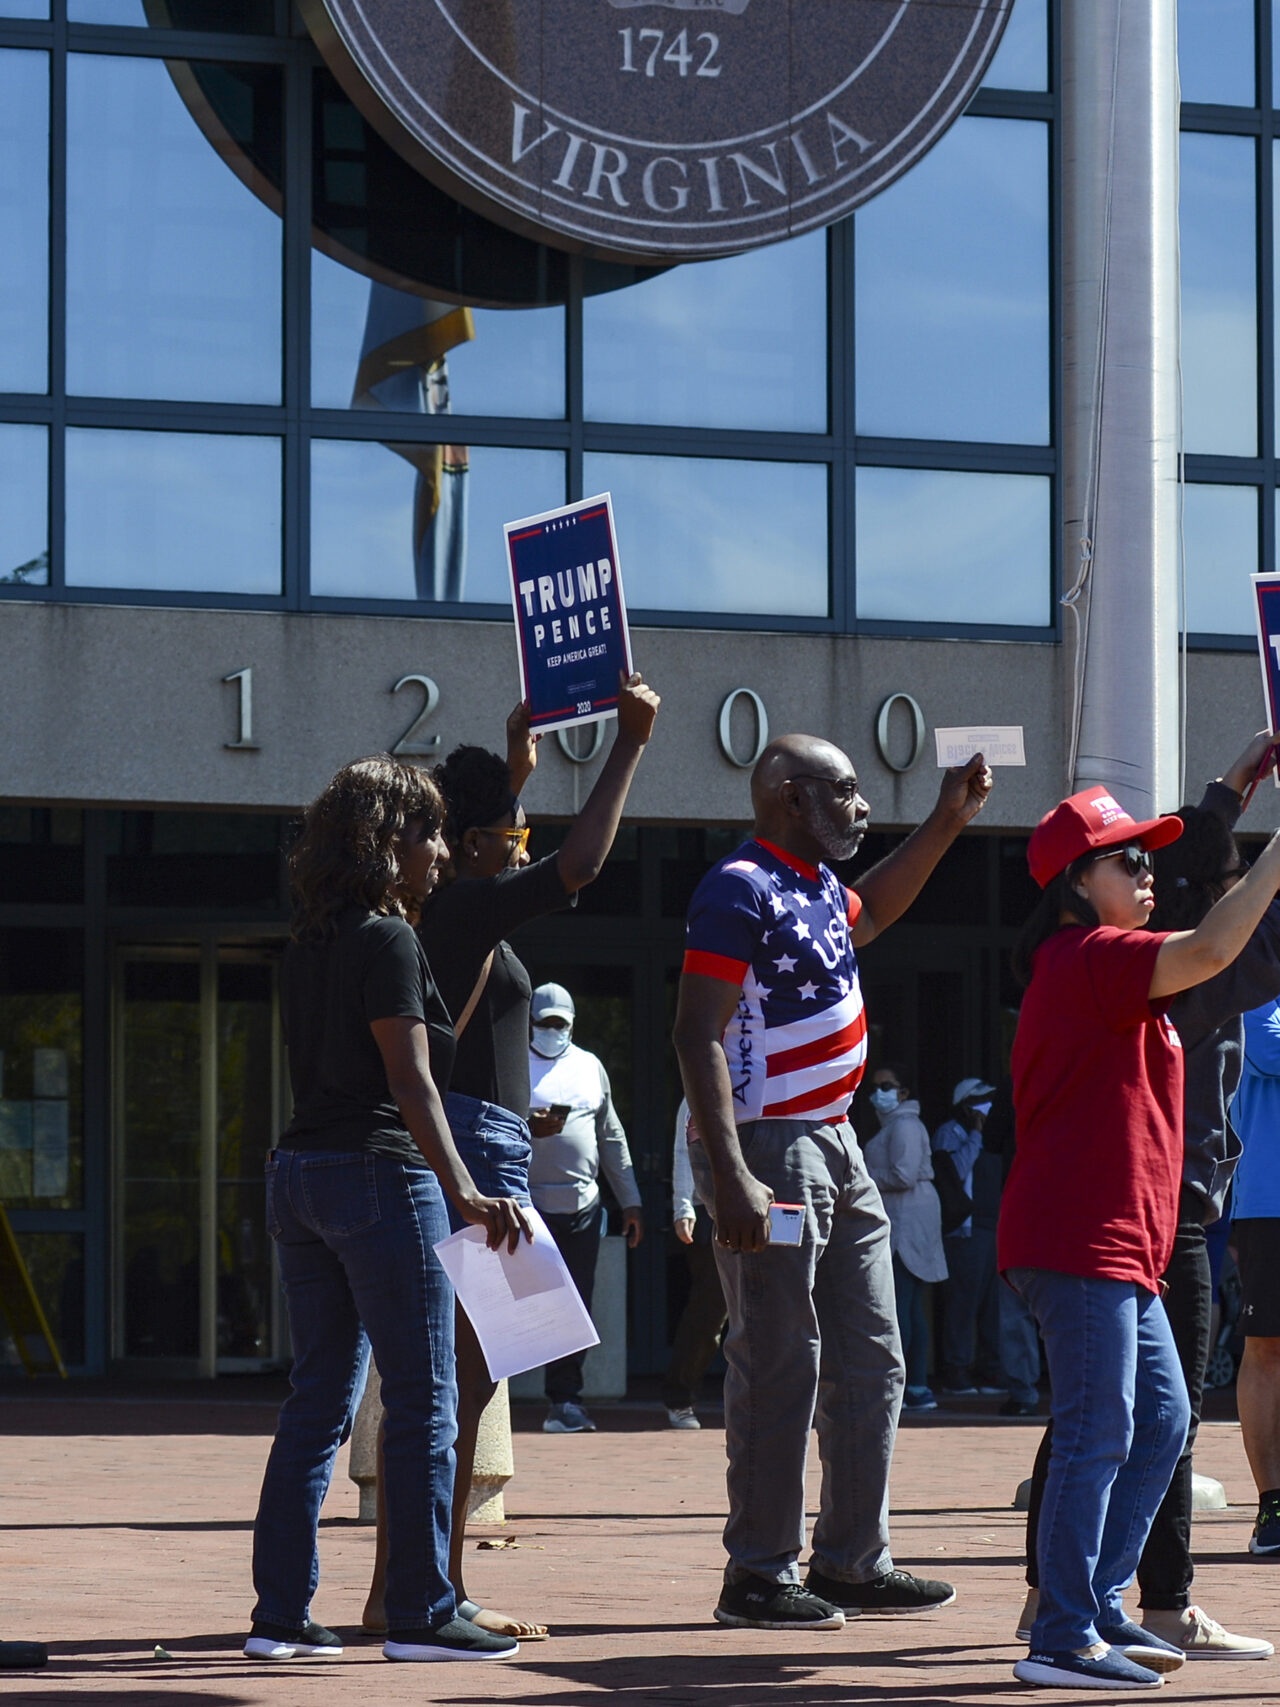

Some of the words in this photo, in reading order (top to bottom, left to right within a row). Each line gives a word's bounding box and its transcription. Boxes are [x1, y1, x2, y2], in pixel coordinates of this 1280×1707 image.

[619, 27, 722, 77] 1742
[510, 101, 876, 213] VIRGINIA
[519, 558, 613, 617] TRUMP
[534, 606, 612, 648] PENCE
[547, 655, 562, 668] KEEP
[563, 649, 587, 664] AMERICA
[588, 643, 607, 658] GREAT!
[577, 701, 591, 714] 2020
[1030, 1654, 1055, 1663] adidas
